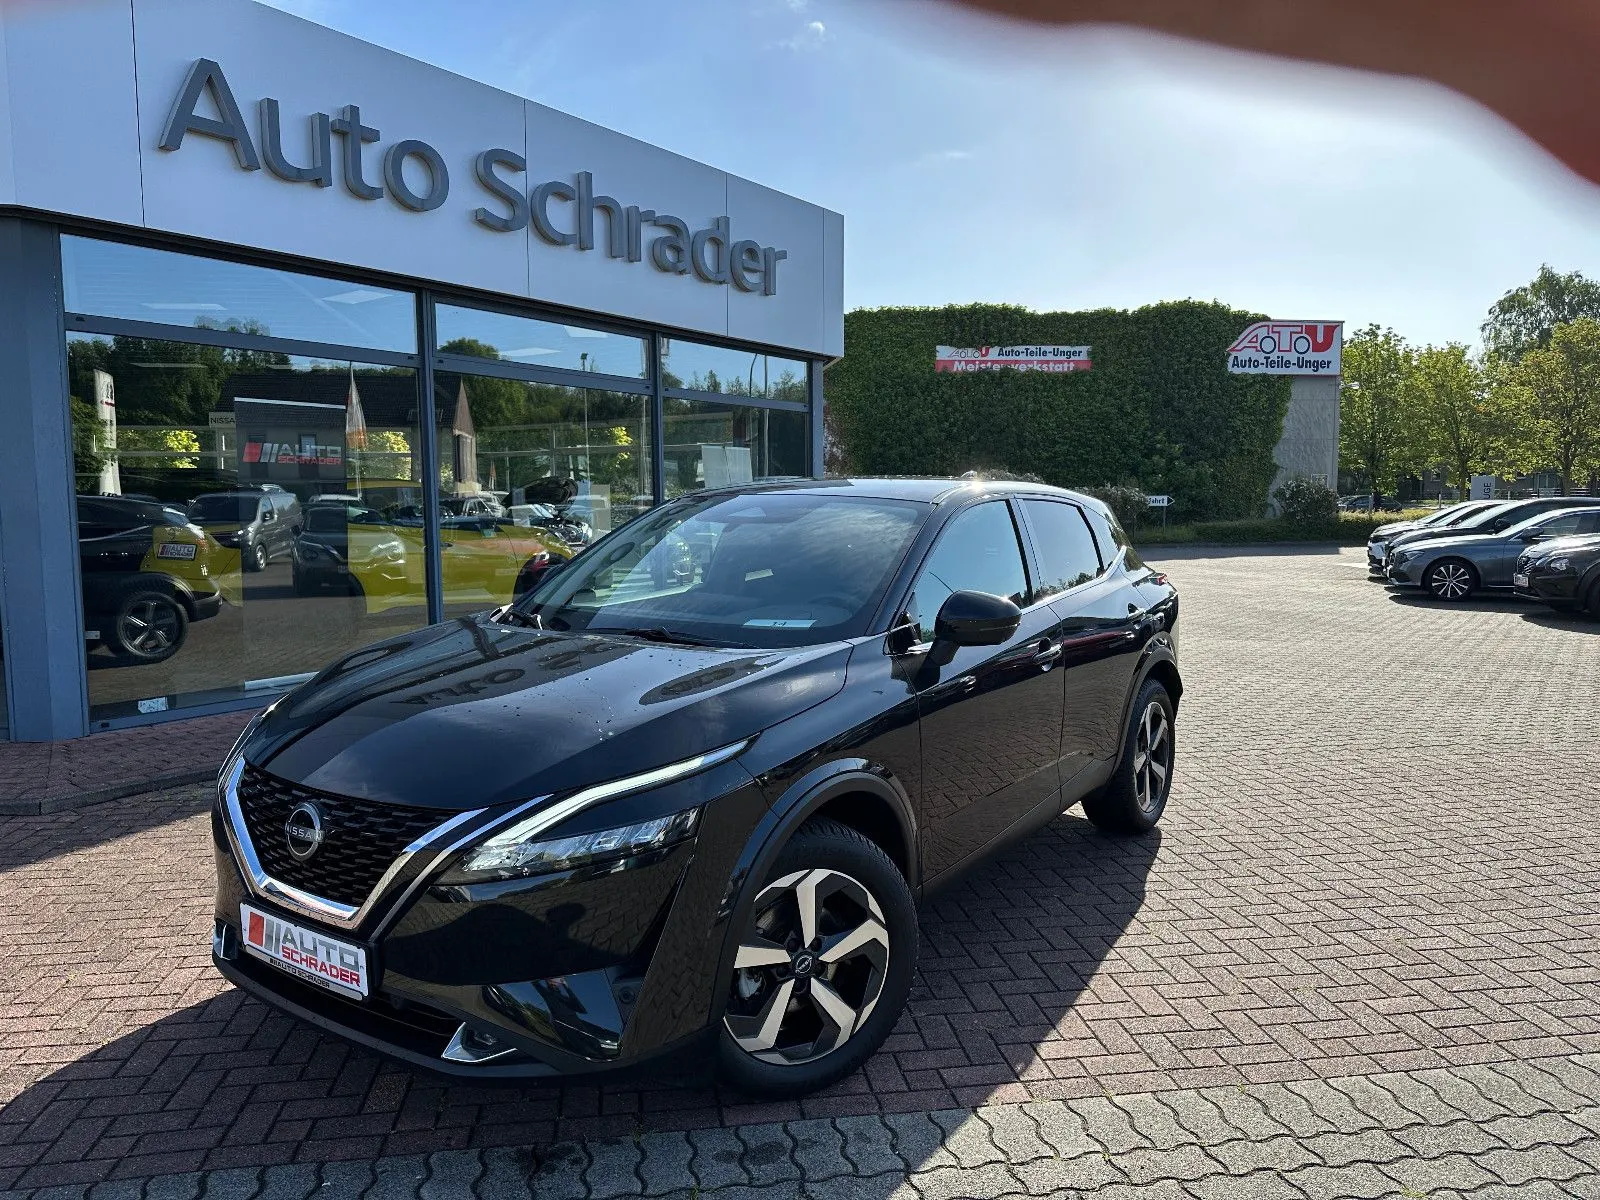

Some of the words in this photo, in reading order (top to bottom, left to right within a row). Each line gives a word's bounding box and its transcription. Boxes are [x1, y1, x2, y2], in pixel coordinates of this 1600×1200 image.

[158, 57, 450, 213] Auto
[475, 147, 788, 296] Schrader
[997, 347, 1082, 359] Auto-Teile-Unger
[1231, 355, 1332, 372] Auto-Teile-Unger
[210, 417, 236, 425] NISSA
[278, 443, 341, 458] AUTO
[281, 926, 360, 972] AUTO
[281, 944, 361, 987] SCHRADER
